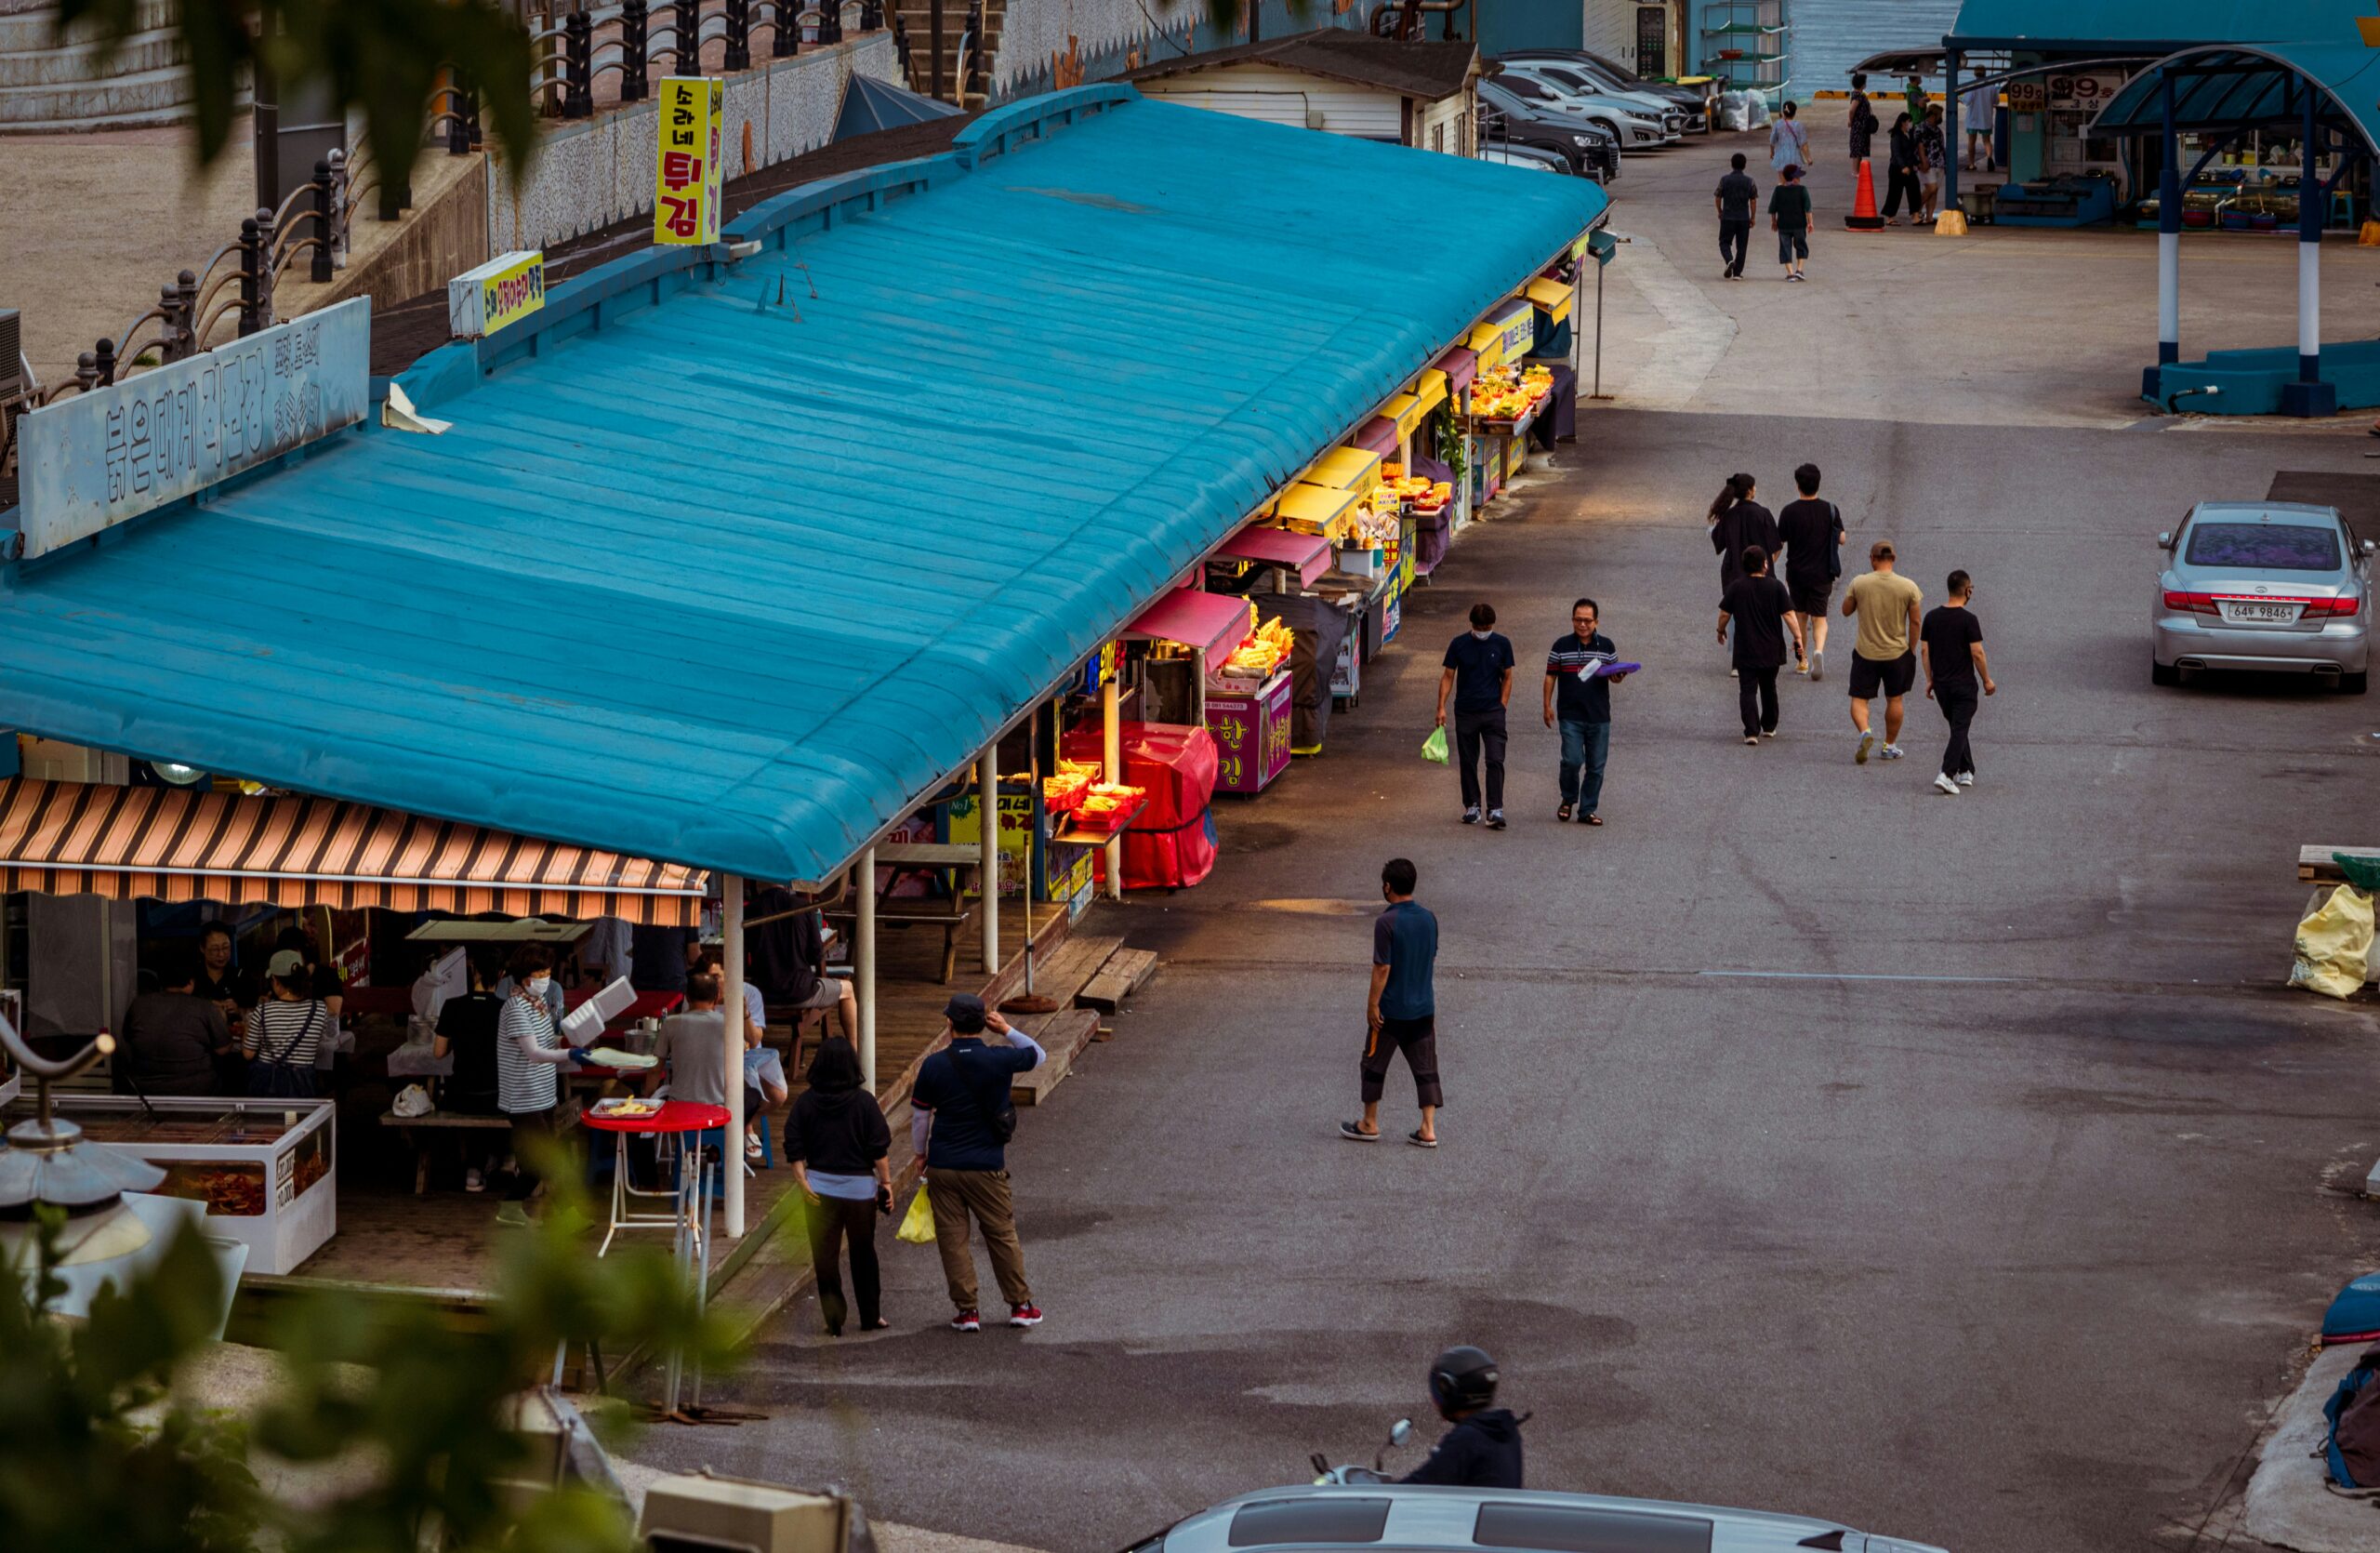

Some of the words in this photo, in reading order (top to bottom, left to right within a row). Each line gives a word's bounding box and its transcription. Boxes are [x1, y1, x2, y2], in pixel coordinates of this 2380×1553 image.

[672, 85, 695, 146] 소라네
[660, 151, 702, 238] 튀김
[2259, 606, 2286, 617] 9846
